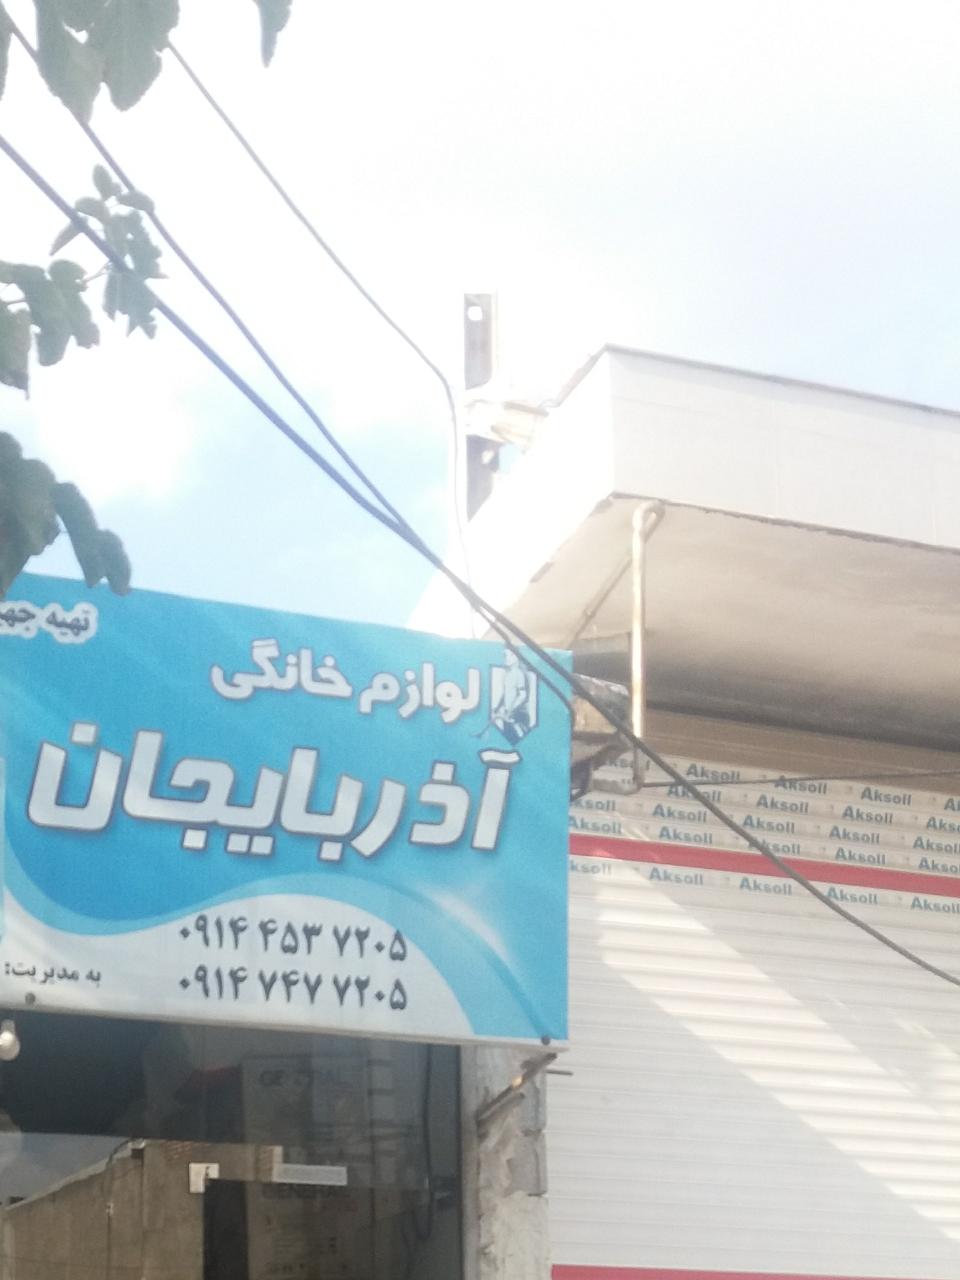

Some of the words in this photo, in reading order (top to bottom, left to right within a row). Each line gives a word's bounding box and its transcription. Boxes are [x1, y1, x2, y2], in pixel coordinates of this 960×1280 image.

[210, 637, 353, 700] خانگی
[359, 660, 482, 724] لوازم
[27, 721, 522, 862] آذربایجان
[755, 793, 809, 814] Aksoll
[842, 805, 893, 825] Aksoll
[860, 785, 913, 807] Aksoll
[652, 803, 708, 823] Aksoll
[743, 814, 795, 835] Aksoll
[829, 824, 880, 845] Aksoll
[659, 825, 713, 845] Aksoll
[834, 846, 886, 866] Aksoll
[649, 866, 703, 886] Aksoll
[740, 876, 793, 896] Aksoll
[826, 886, 878, 905] Aksoll
[85, 966, 102, 988] به
